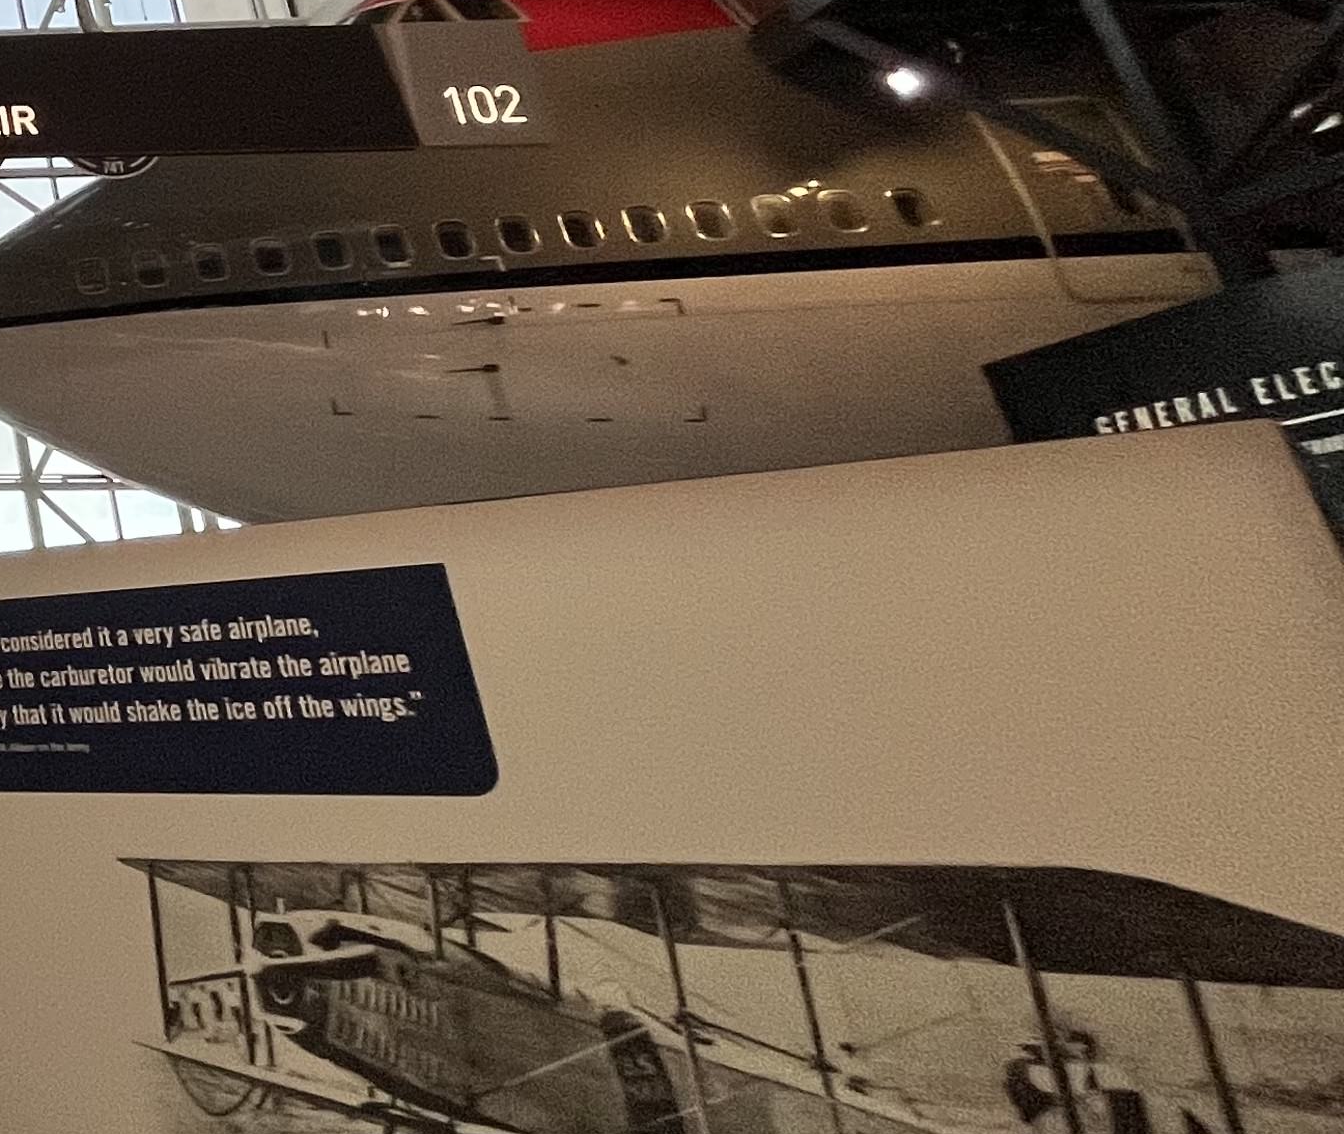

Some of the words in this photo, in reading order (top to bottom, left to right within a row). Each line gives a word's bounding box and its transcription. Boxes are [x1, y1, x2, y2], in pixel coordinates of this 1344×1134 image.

[443, 84, 528, 125] 102
[1250, 361, 1344, 405] ELEC
[1, 627, 93, 653] considered
[99, 626, 112, 647] it
[116, 629, 129, 646] a
[132, 626, 173, 648] very
[179, 619, 222, 643] safe
[228, 615, 319, 643] airplane,
[7, 667, 35, 689] the
[40, 665, 134, 688] carburetor
[140, 659, 195, 683] would
[200, 657, 272, 681] vibrate
[277, 654, 313, 678] the
[319, 650, 412, 680] airplane
[12, 704, 47, 725] that
[51, 703, 65, 724] it
[69, 701, 121, 724] would
[126, 698, 182, 722] shake
[187, 698, 219, 722] the
[224, 697, 256, 720] ice
[263, 695, 294, 719] off
[298, 695, 334, 718] the
[339, 690, 424, 722] wings."
